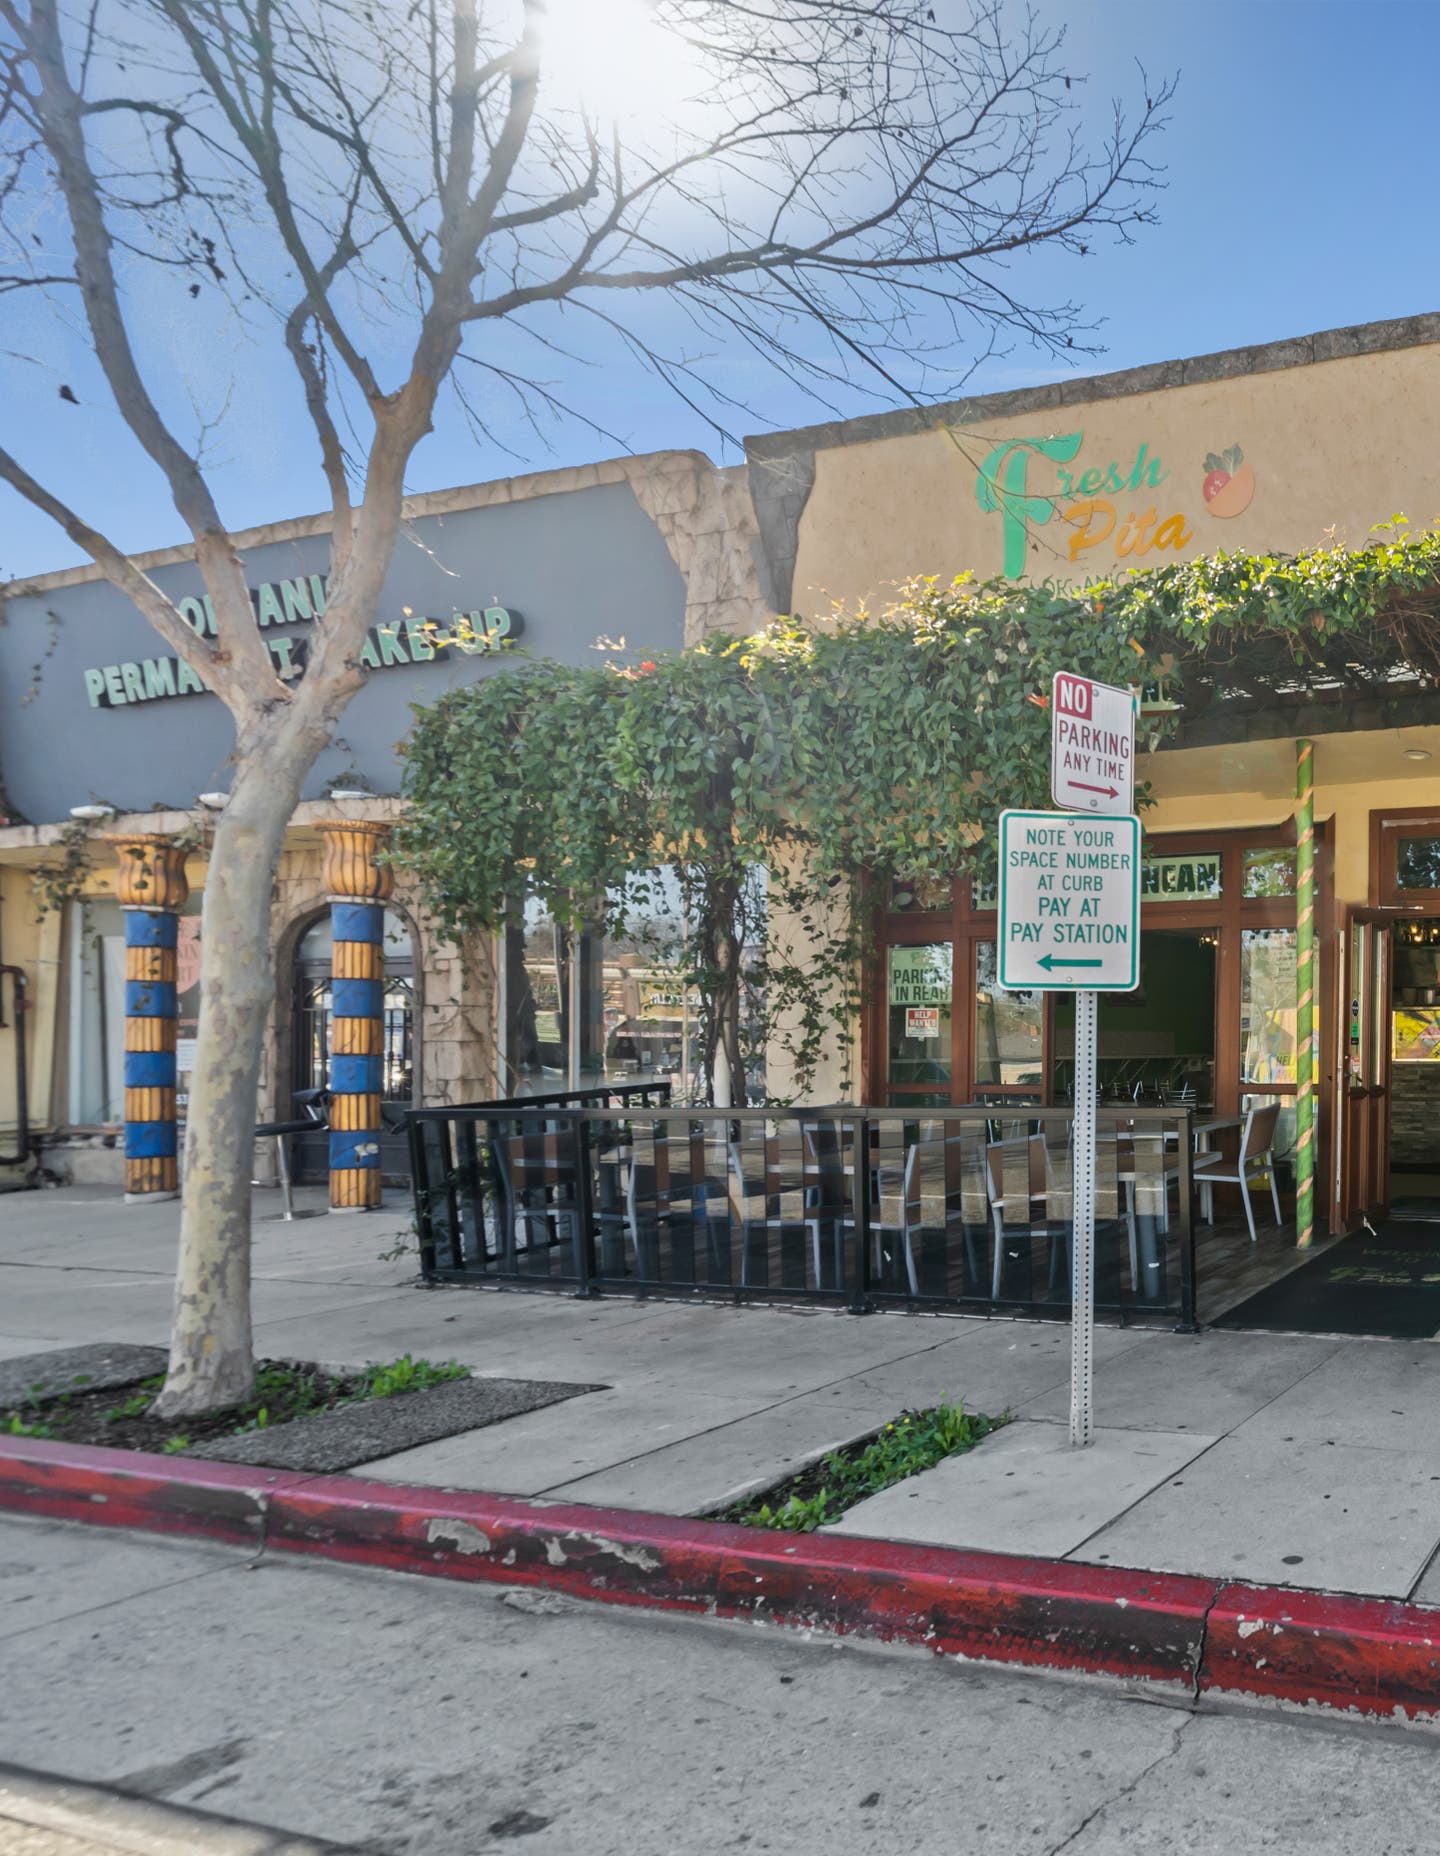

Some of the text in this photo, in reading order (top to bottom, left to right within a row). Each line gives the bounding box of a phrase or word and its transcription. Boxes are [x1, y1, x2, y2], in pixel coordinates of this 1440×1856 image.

[975, 430, 1171, 580] Fresh
[1063, 500, 1193, 561] Pita
[84, 607, 511, 708] PERMAT AKE-UP
[1060, 680, 1088, 714] NO
[1059, 719, 1129, 759] PARKING
[1063, 750, 1125, 781] ANY TIME
[1026, 829, 1114, 847] NOTE YOUR
[1009, 850, 1130, 870] SPACE NUMBER
[1037, 874, 1103, 891] AT CURB
[1038, 897, 1102, 918] PAY AT
[1010, 922, 1128, 944] PAY STATION
[895, 986, 909, 1001] IN
